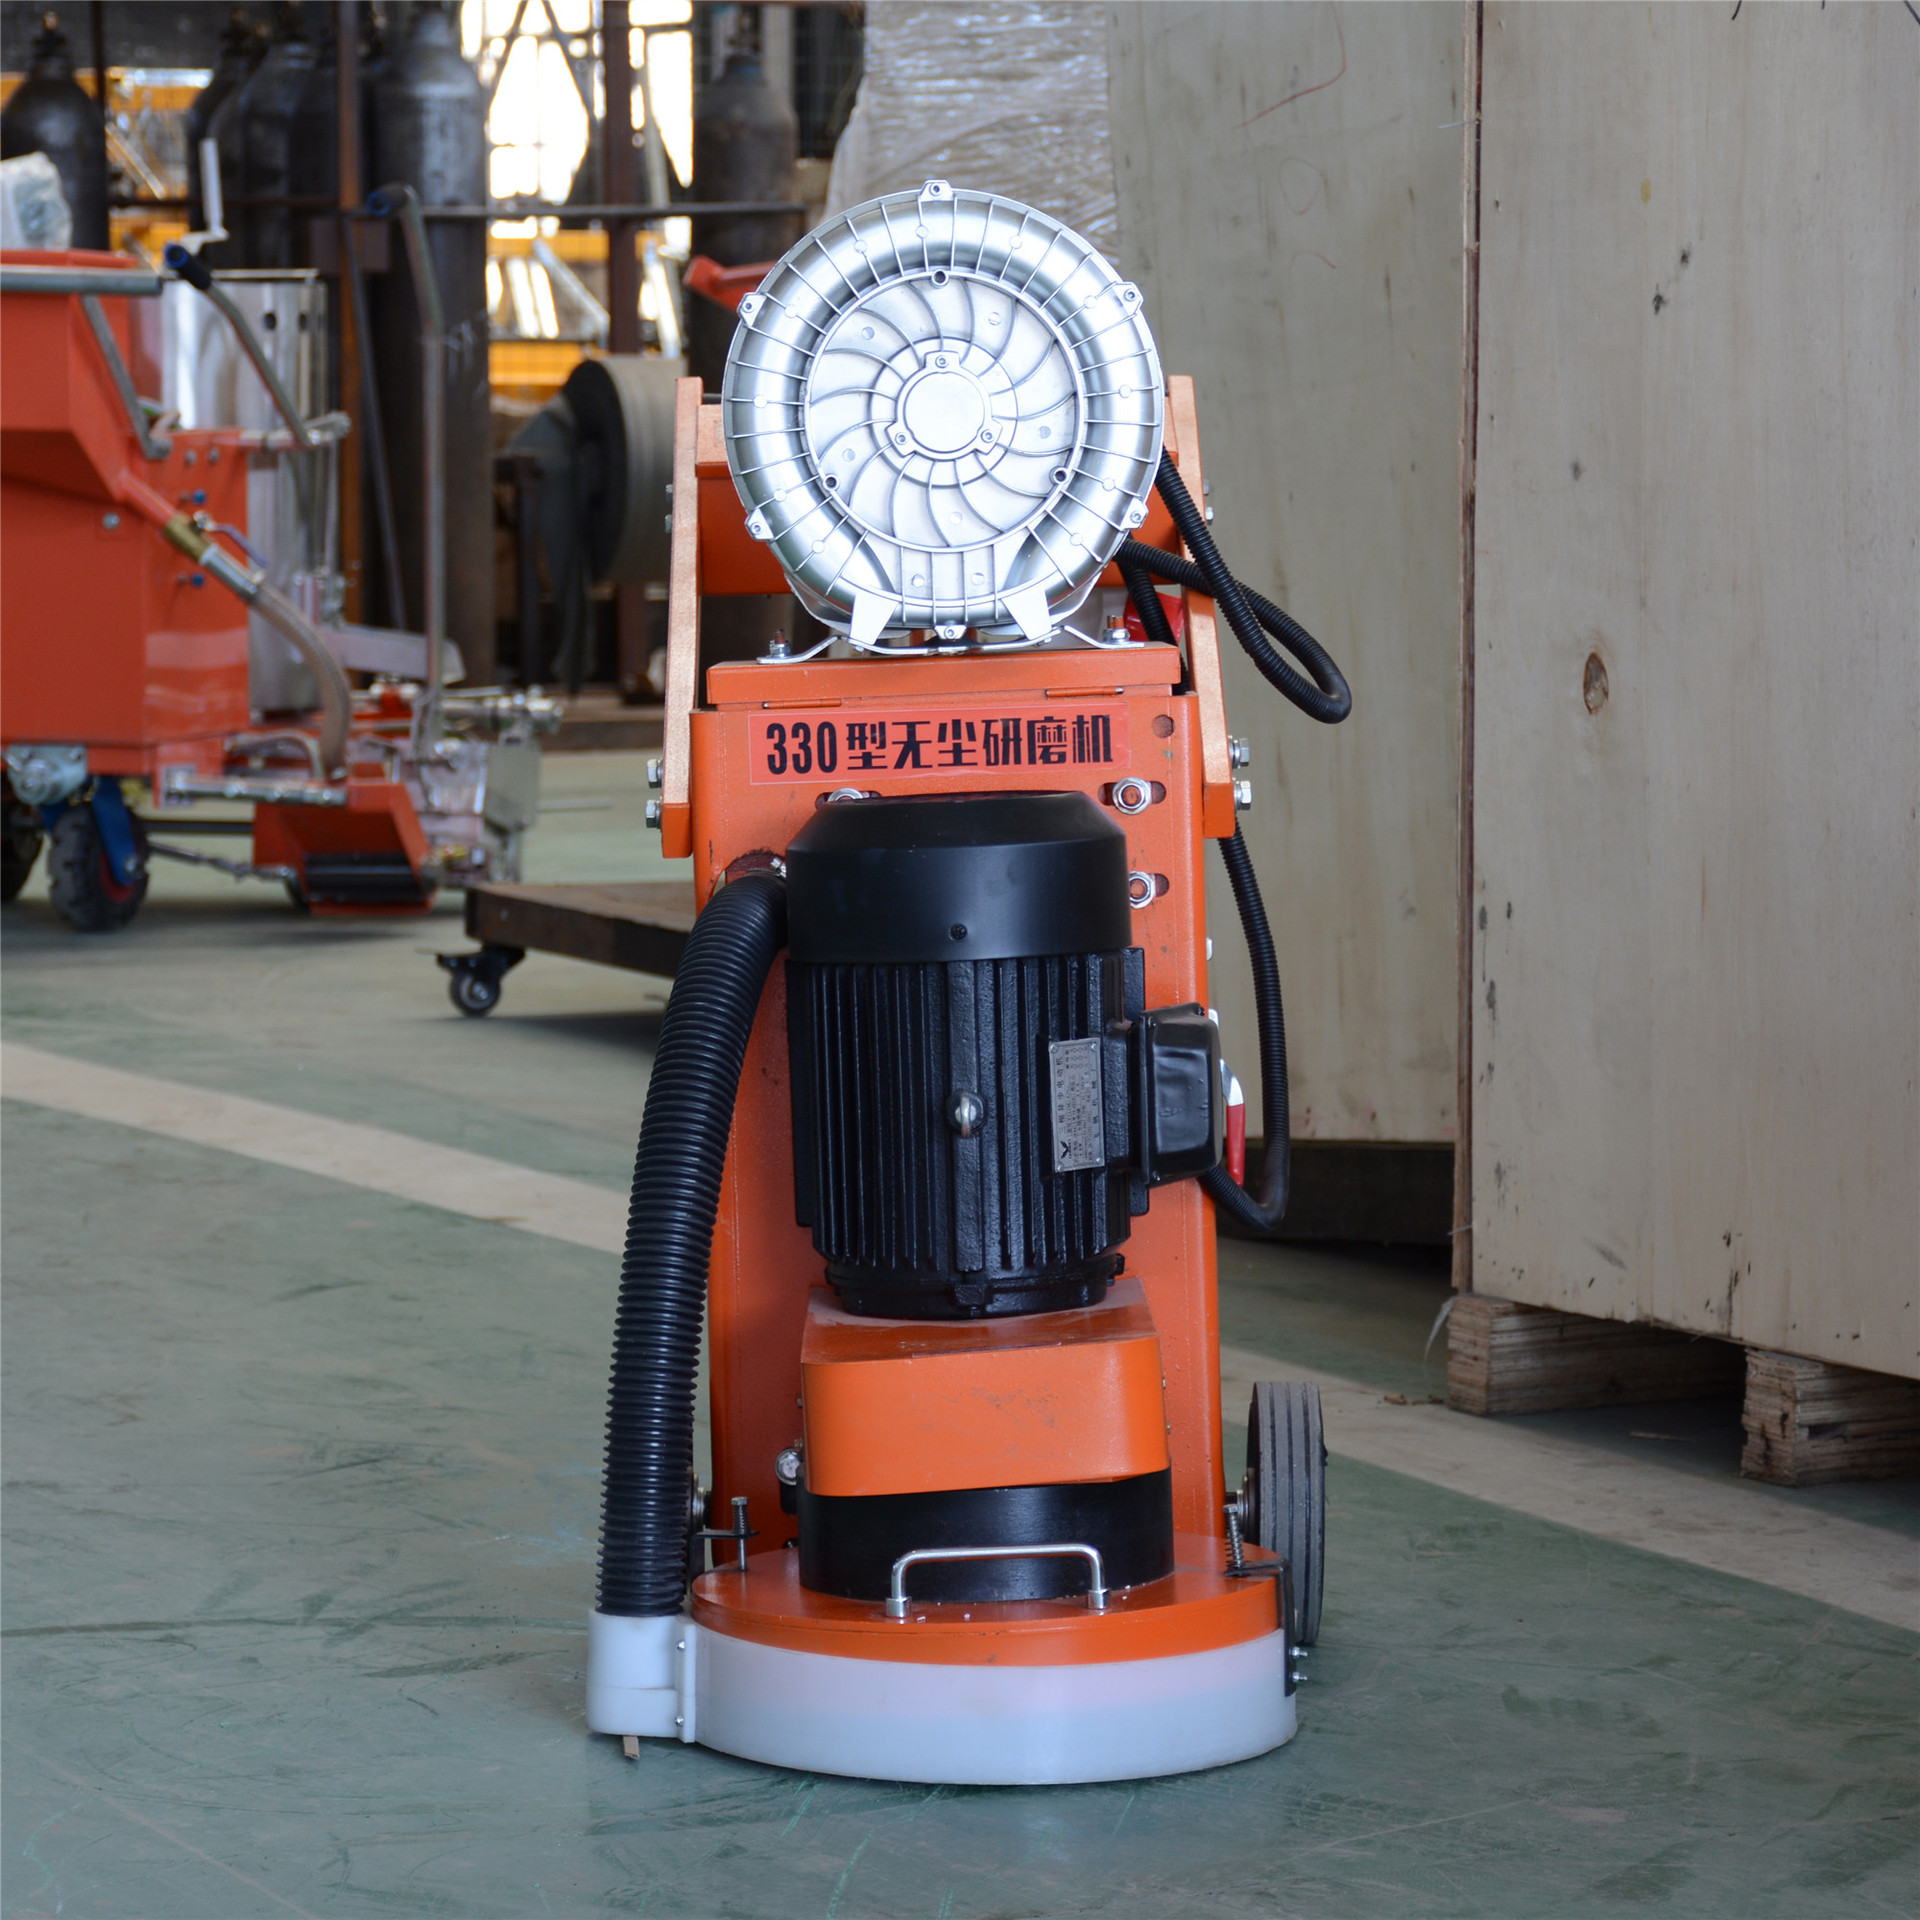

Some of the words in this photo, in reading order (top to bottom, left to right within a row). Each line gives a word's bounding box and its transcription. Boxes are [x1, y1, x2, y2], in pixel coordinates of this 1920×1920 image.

[766, 715, 1114, 775] 330型无尘研磨机
